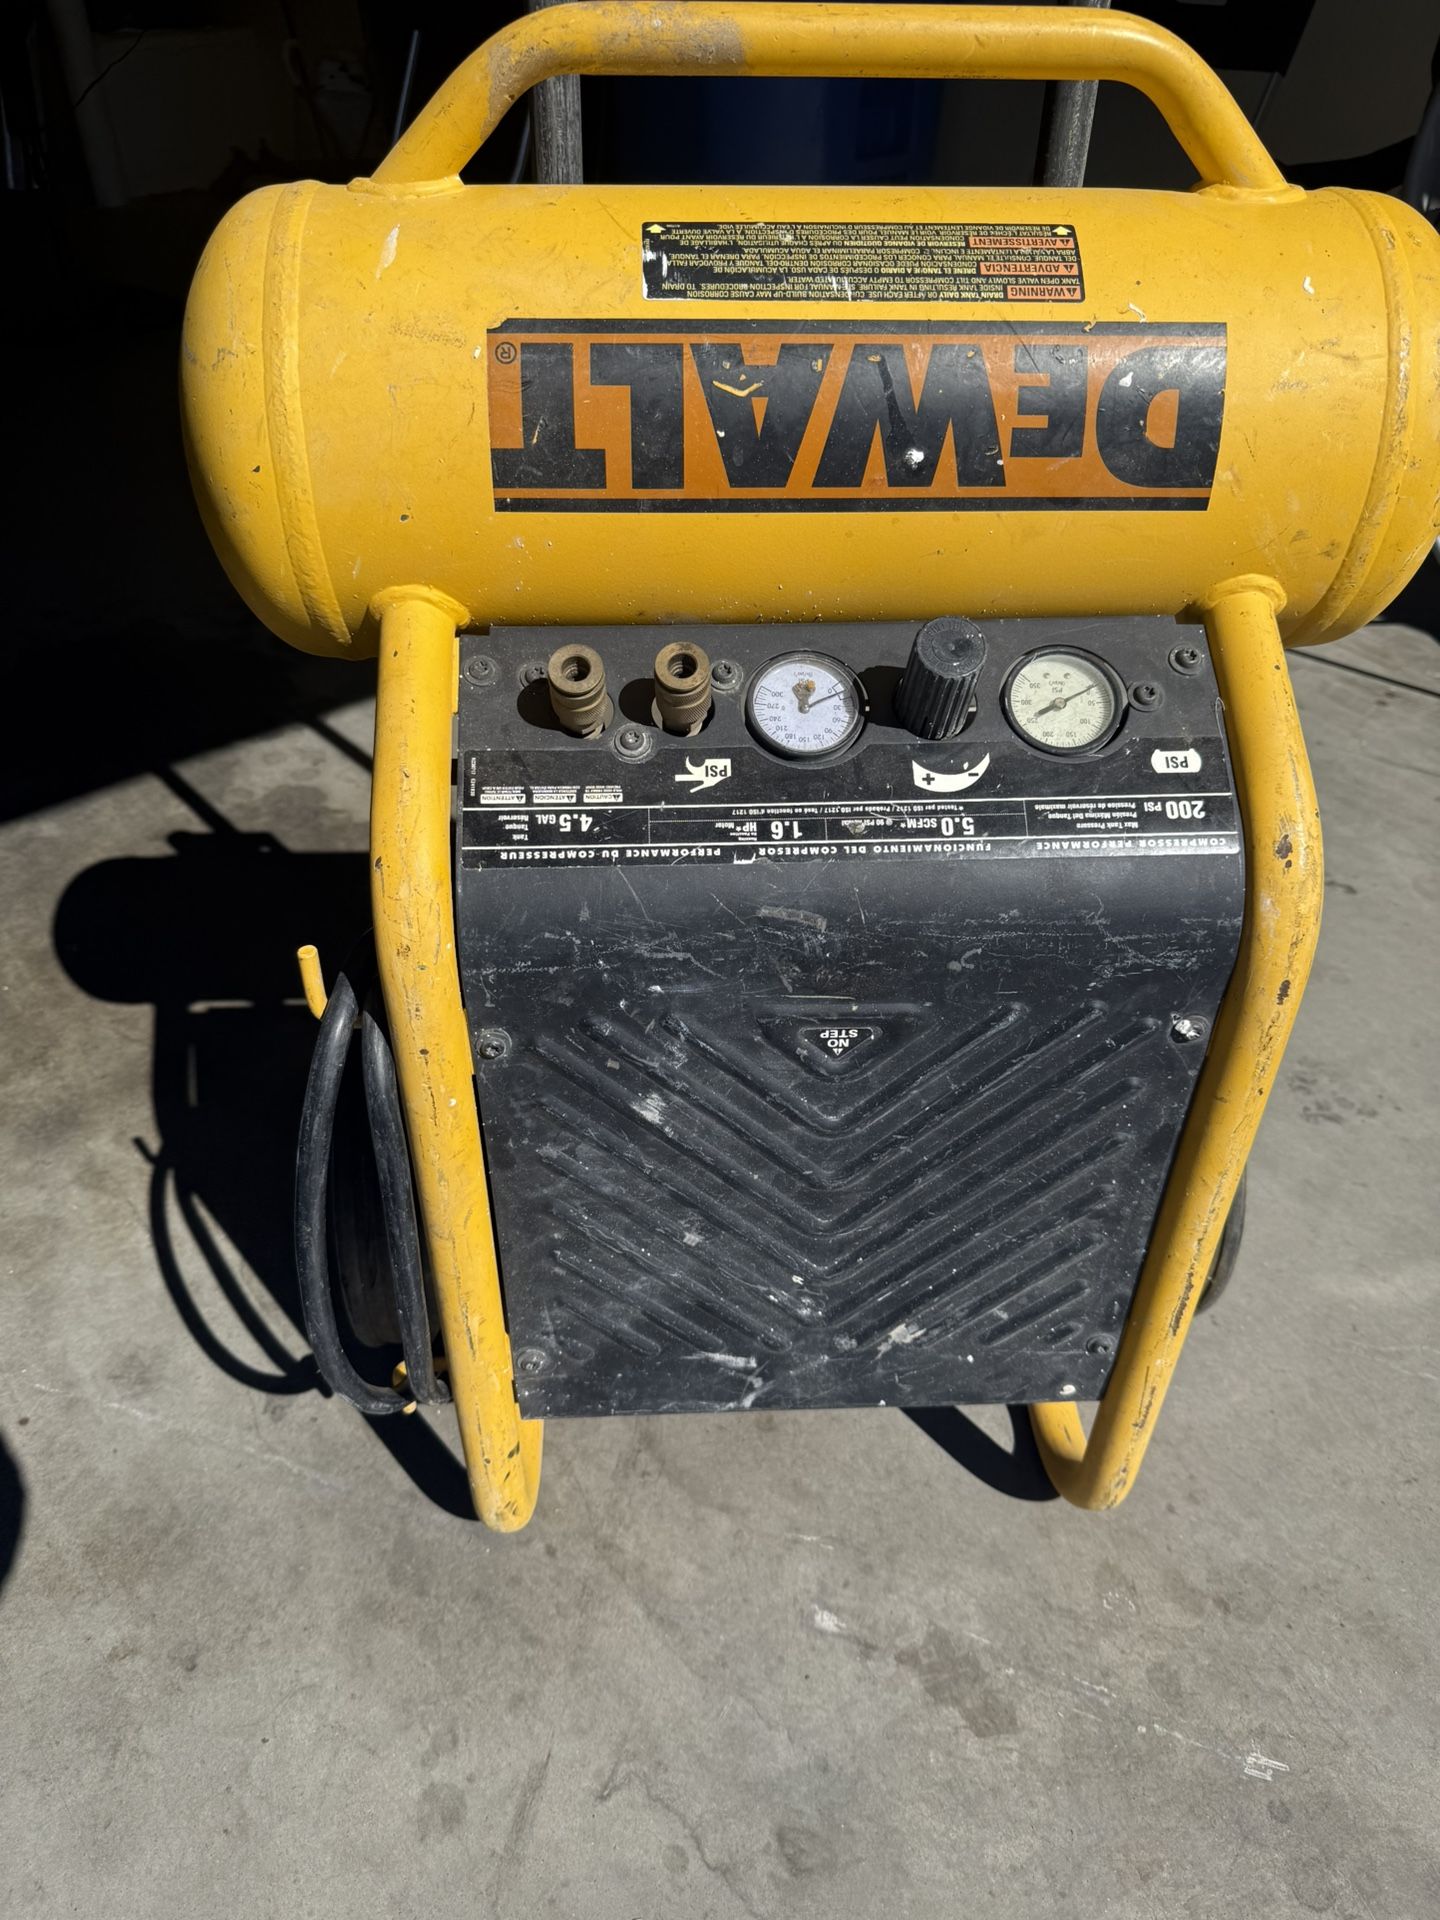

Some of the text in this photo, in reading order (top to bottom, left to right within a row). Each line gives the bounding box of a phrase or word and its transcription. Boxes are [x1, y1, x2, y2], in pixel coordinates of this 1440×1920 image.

[973, 238, 1057, 246] AVERTISSEMENT
[840, 267, 873, 275] DESPUÉS
[984, 264, 1060, 272] ADVERTENCIA
[1011, 287, 1065, 297] WARNING
[1165, 756, 1188, 768] PSI
[705, 766, 728, 777] PSI
[1144, 800, 1205, 819] 200 PSI
[1048, 812, 1071, 820] Tanque
[505, 823, 528, 831] Tanque
[535, 814, 593, 832] 4.5 GAL
[941, 817, 974, 836] 5.0
[771, 821, 802, 839] 1.6
[1036, 838, 1226, 849] COMPRESSOR PERFORMANCE
[500, 849, 720, 859] PERFORMANCE DU COMPRESSEUR
[758, 844, 990, 854] FUNCIONAMIENTO DEL COMPRESOR
[820, 1029, 858, 1038] STEP
[827, 1039, 849, 1047] NO
